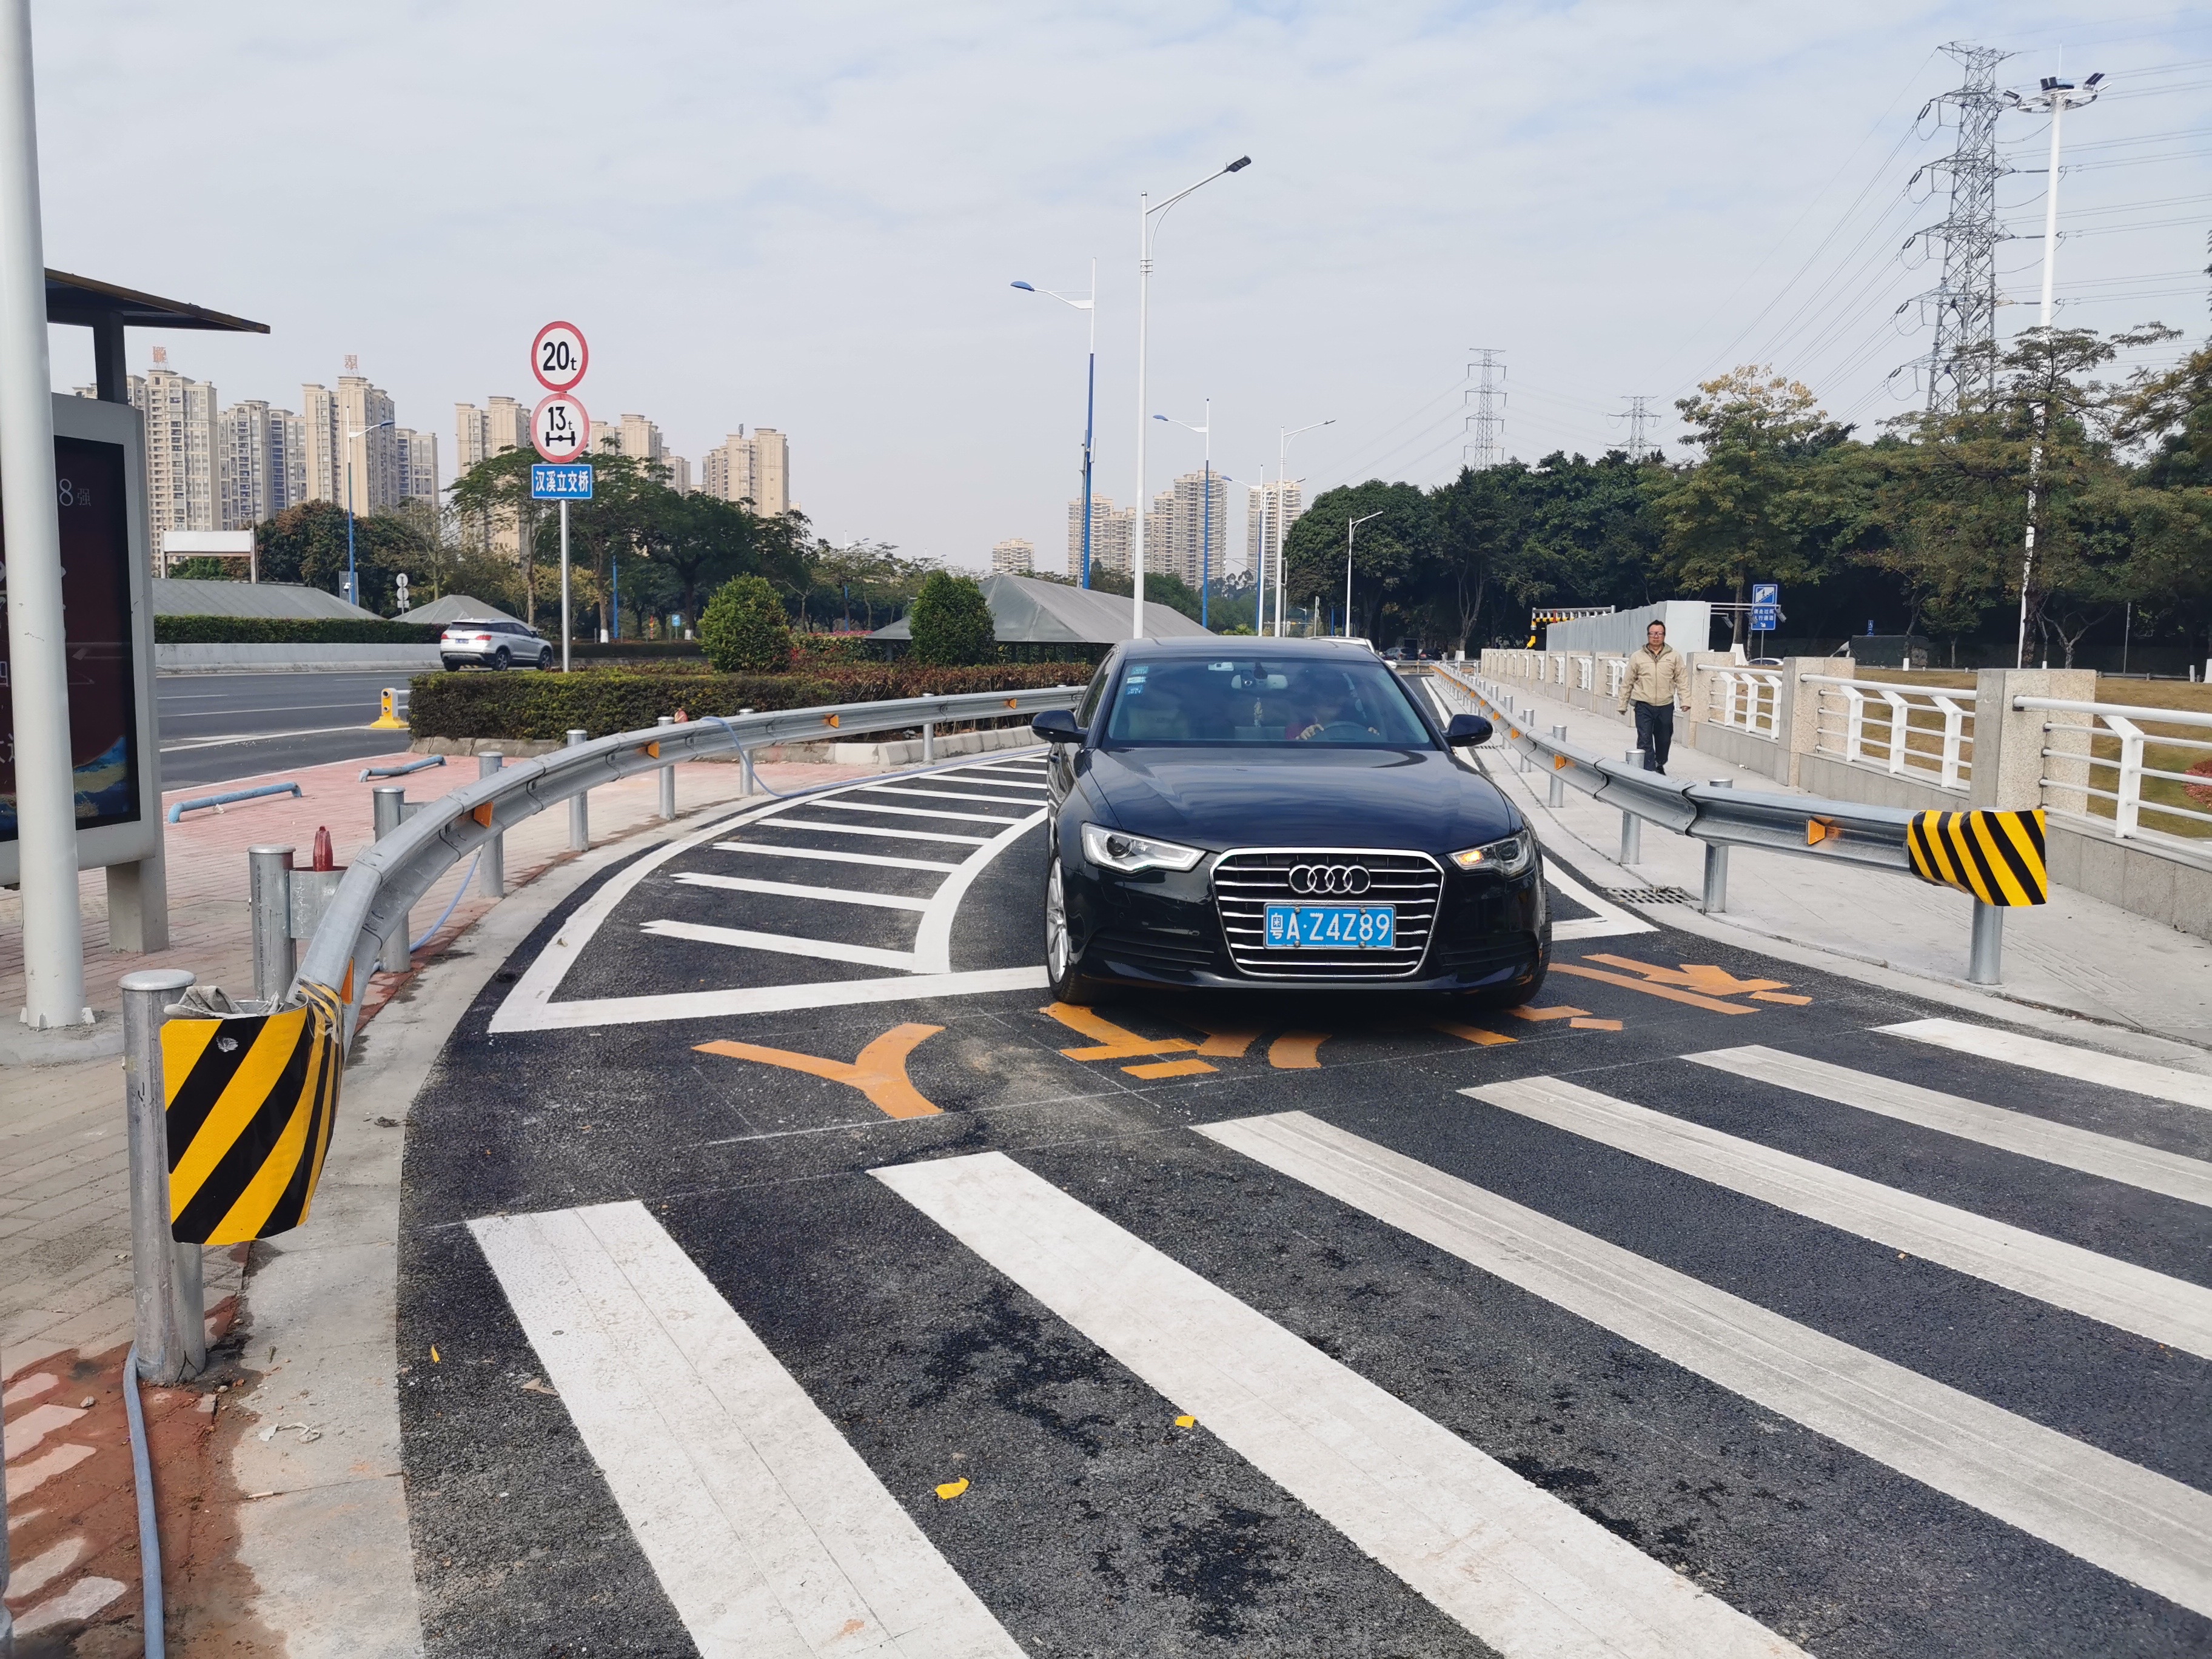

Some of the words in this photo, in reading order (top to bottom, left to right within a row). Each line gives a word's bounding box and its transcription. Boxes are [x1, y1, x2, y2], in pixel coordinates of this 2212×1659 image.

[543, 341, 577, 371] 20t
[548, 406, 572, 431] 13t
[535, 470, 589, 493] 汉溪立交桥
